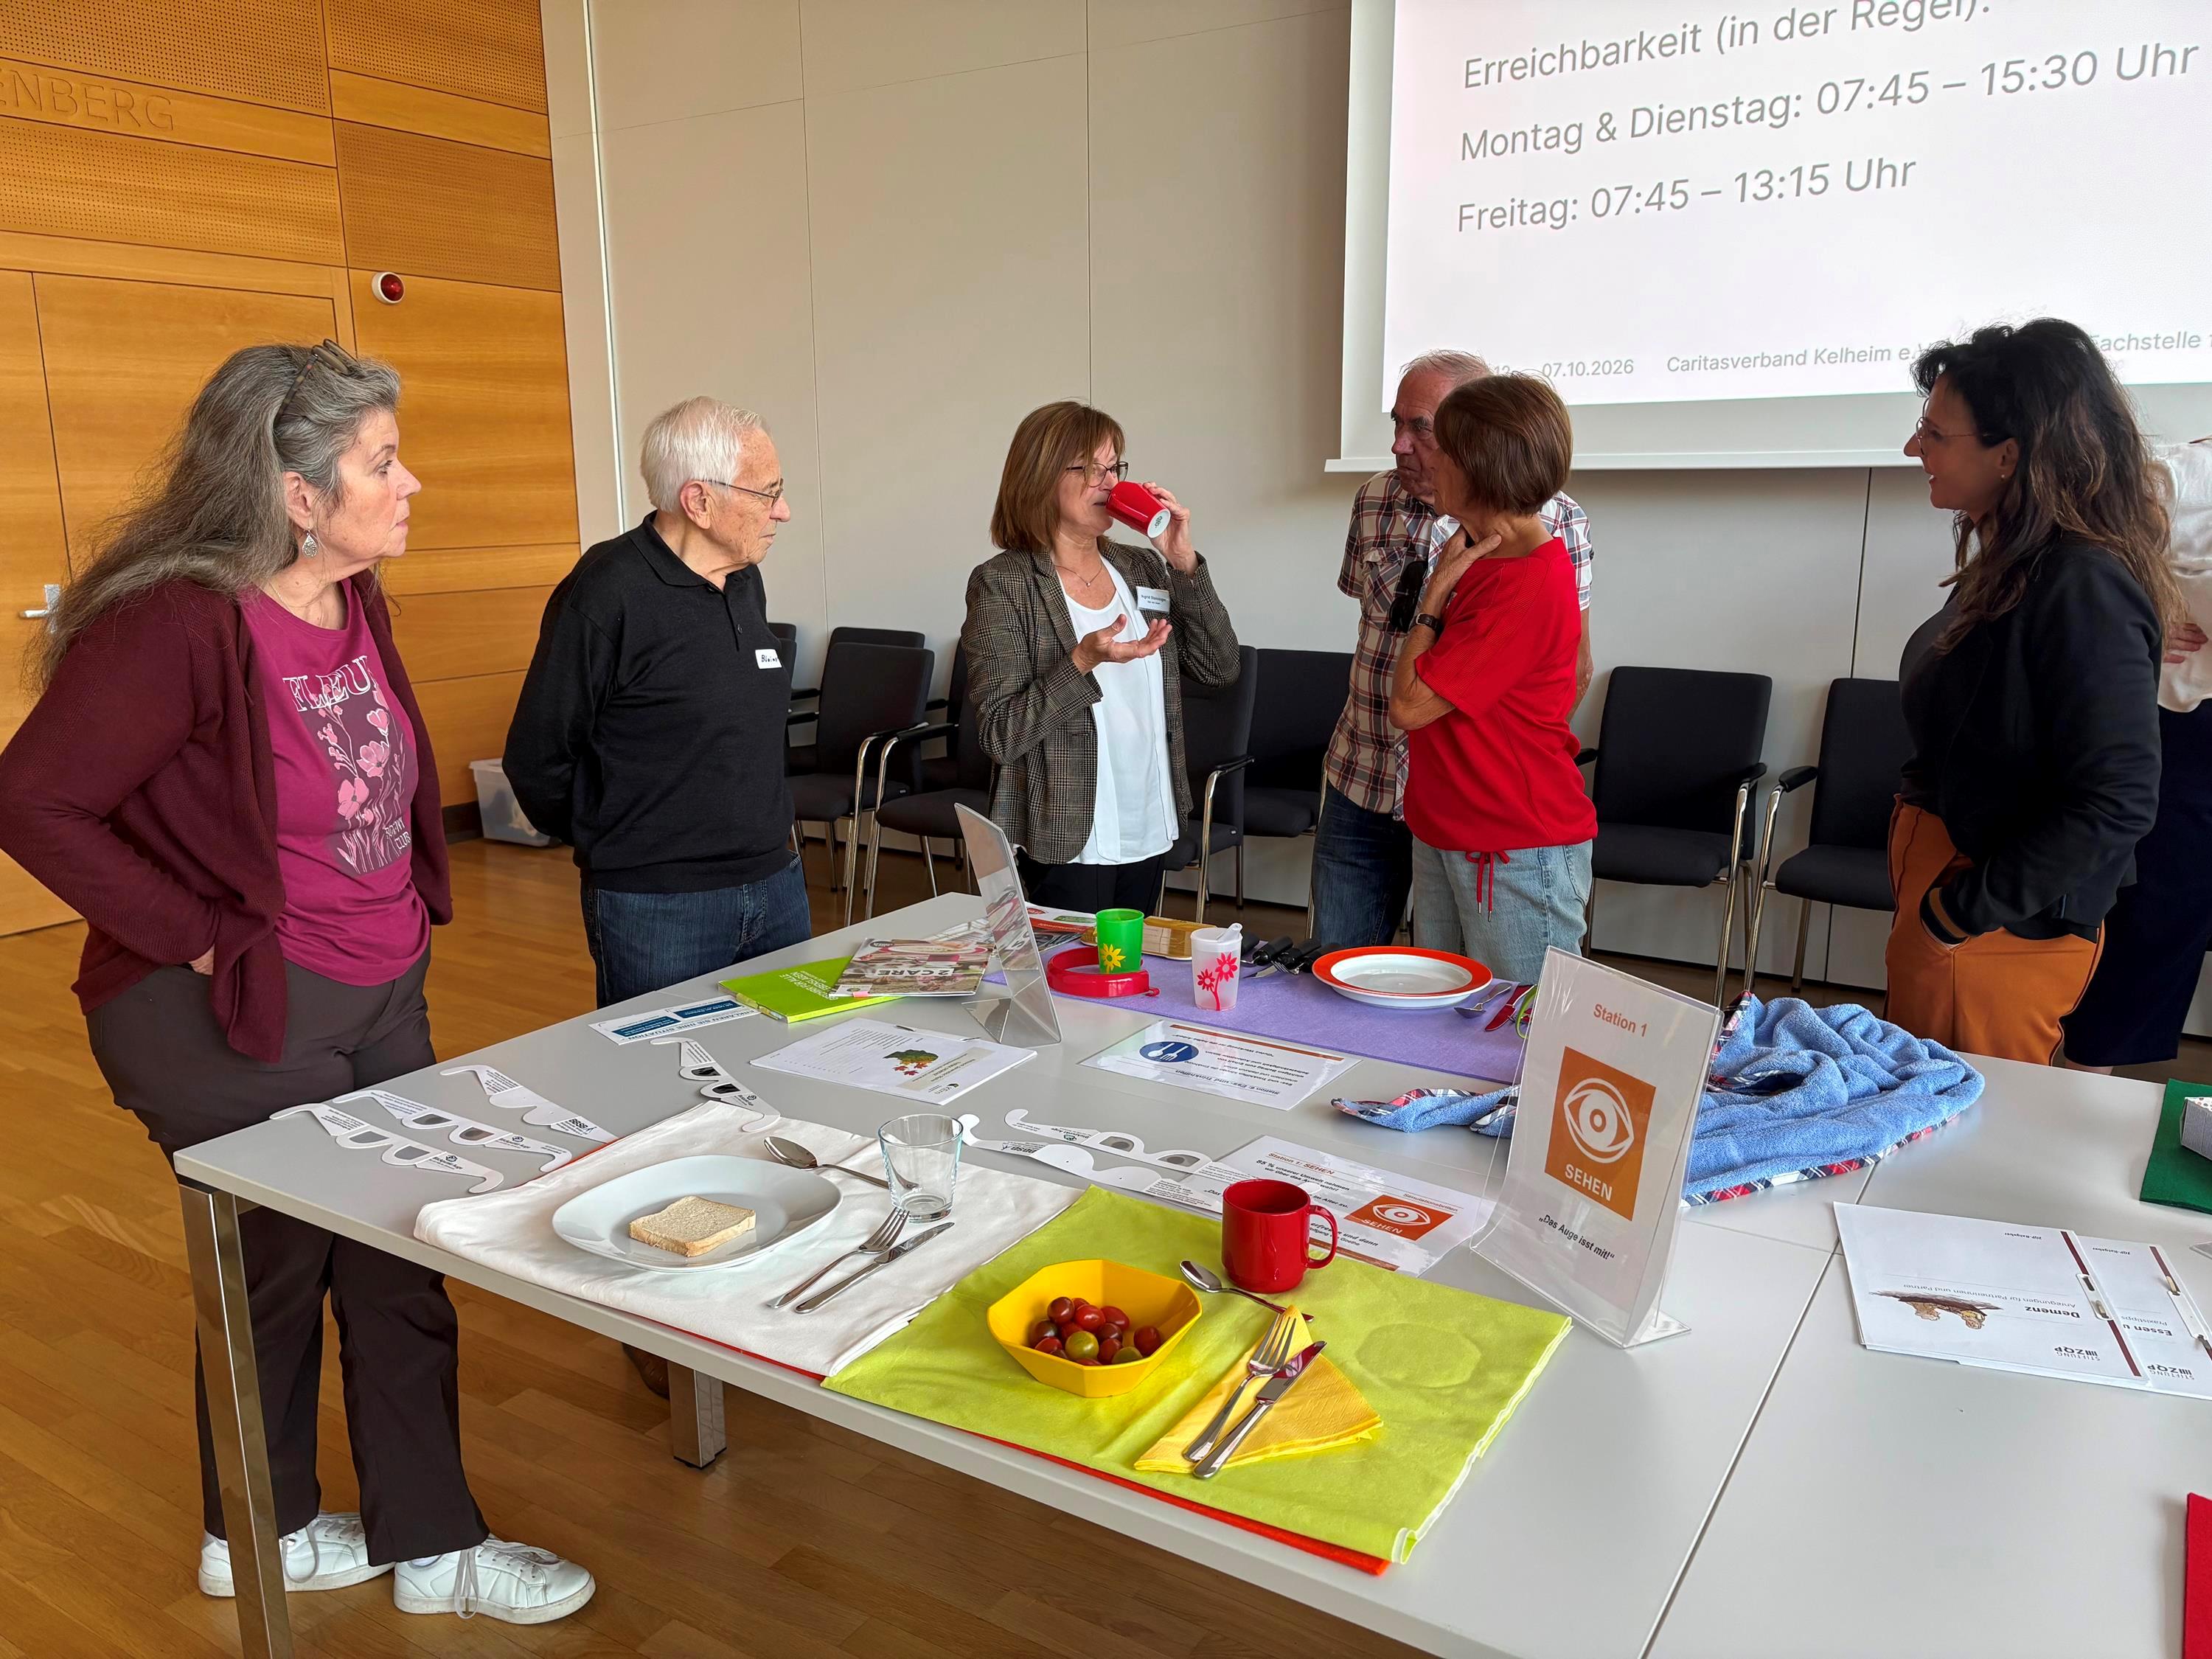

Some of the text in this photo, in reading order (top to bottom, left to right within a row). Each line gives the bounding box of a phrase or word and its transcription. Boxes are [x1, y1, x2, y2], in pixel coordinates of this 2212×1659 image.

[1464, 24, 1702, 88] Erreichbarkeit
[1717, 15, 1759, 55] (in
[1773, 8, 1838, 41] der
[1461, 122, 1583, 161] Montag
[1596, 111, 1618, 143] &
[1630, 94, 1801, 139] Dienstag:
[1817, 71, 1930, 114] 07:45
[1980, 50, 2097, 96] 15:30
[2116, 42, 2199, 81] Uhr
[1458, 198, 1578, 232] Freitag:
[1591, 178, 1689, 218] 07:45
[1734, 162, 1830, 203] 13:15
[1845, 156, 1916, 192] Uhr
[1667, 347, 1806, 373] Caritasverband
[1815, 346, 1891, 366] Kelheim
[1542, 358, 1634, 378] 07.10.2026
[1593, 1002, 1648, 1037] Station 1
[1269, 1152, 1295, 1164] Station
[1304, 1163, 1335, 1175] SEHEN
[1274, 1169, 1289, 1178] über
[1289, 1174, 1302, 1182] das
[1275, 1165, 1298, 1176] unserer
[1300, 1171, 1324, 1183] Umwelt
[1324, 1178, 1350, 1192] nehmen
[1565, 1164, 1613, 1202] SEHEN
[1363, 1218, 1403, 1234] SEHEN
[1338, 1237, 1362, 1246] Goethe
[1341, 1232, 1359, 1240] und
[1357, 1237, 1380, 1247] dann
[1539, 1214, 1615, 1260] „Das Auge isst mit!“
[1903, 1284, 1933, 1293] Partner
[1934, 1286, 1952, 1295] und
[1952, 1289, 2008, 1301] Partnerinnen
[2023, 1297, 2076, 1309] Anregungen
[2025, 1305, 2081, 1319] Demenz
[2121, 1315, 2168, 1326] Praxistipps
[2134, 1325, 2173, 1337] Essen
[2056, 1352, 2101, 1362] STIFTUNG
[2149, 1369, 2195, 1380] STIFTUNG
